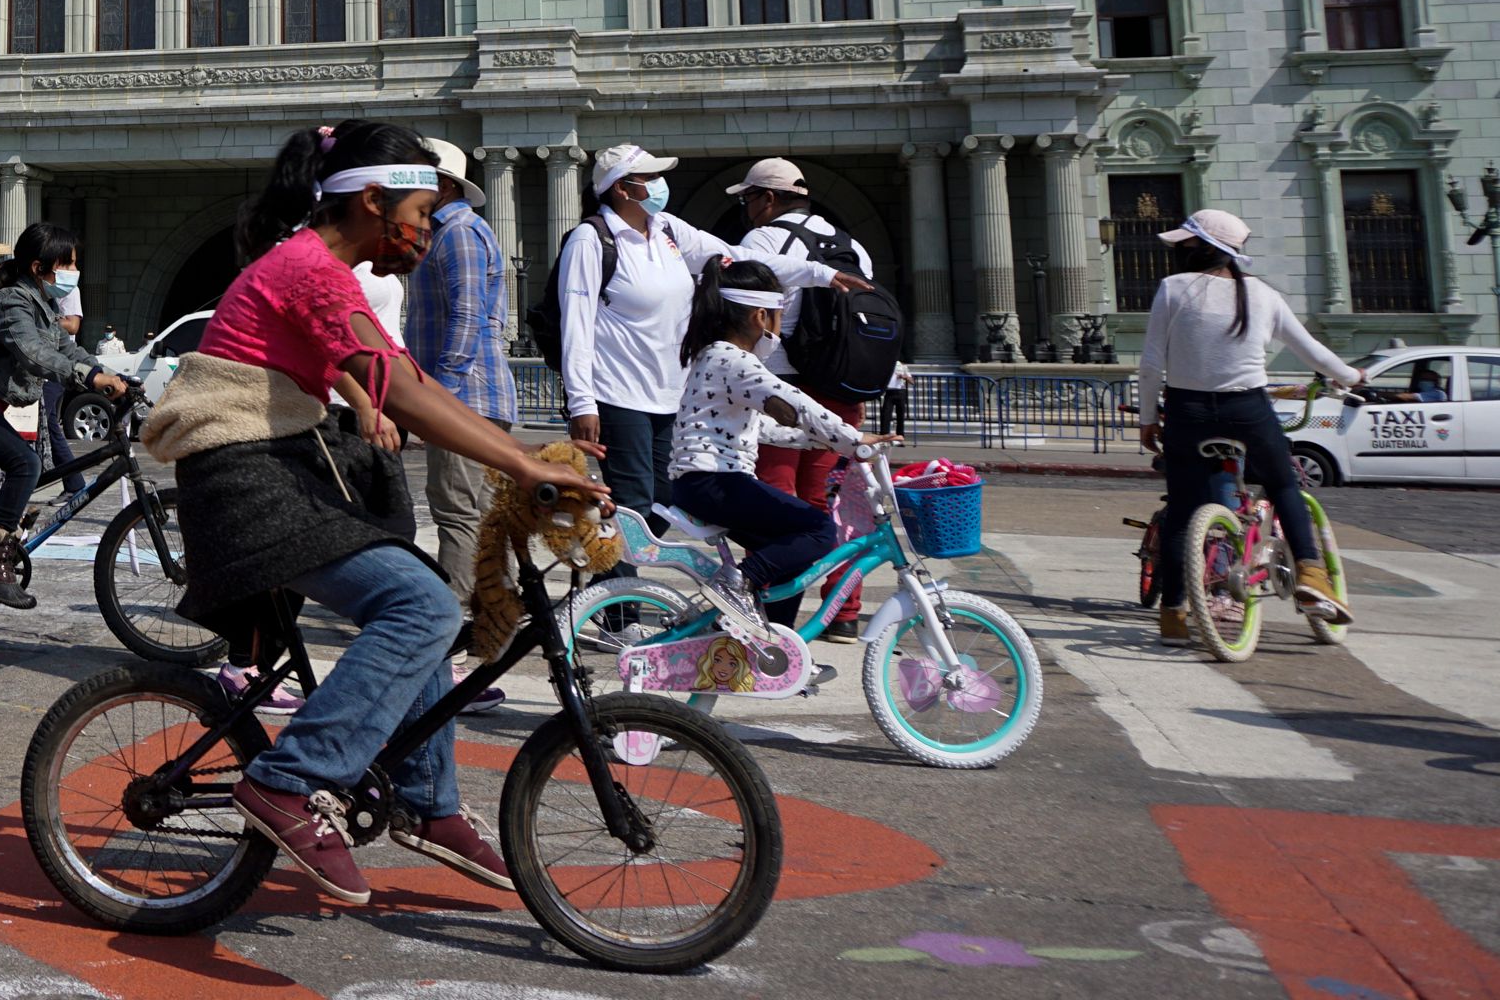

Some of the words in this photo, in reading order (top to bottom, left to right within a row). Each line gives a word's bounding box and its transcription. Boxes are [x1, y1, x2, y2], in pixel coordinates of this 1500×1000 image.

[1367, 411, 1425, 424] TAXI
[1371, 426, 1426, 438] 15657
[1372, 440, 1428, 449] GUATEMALA
